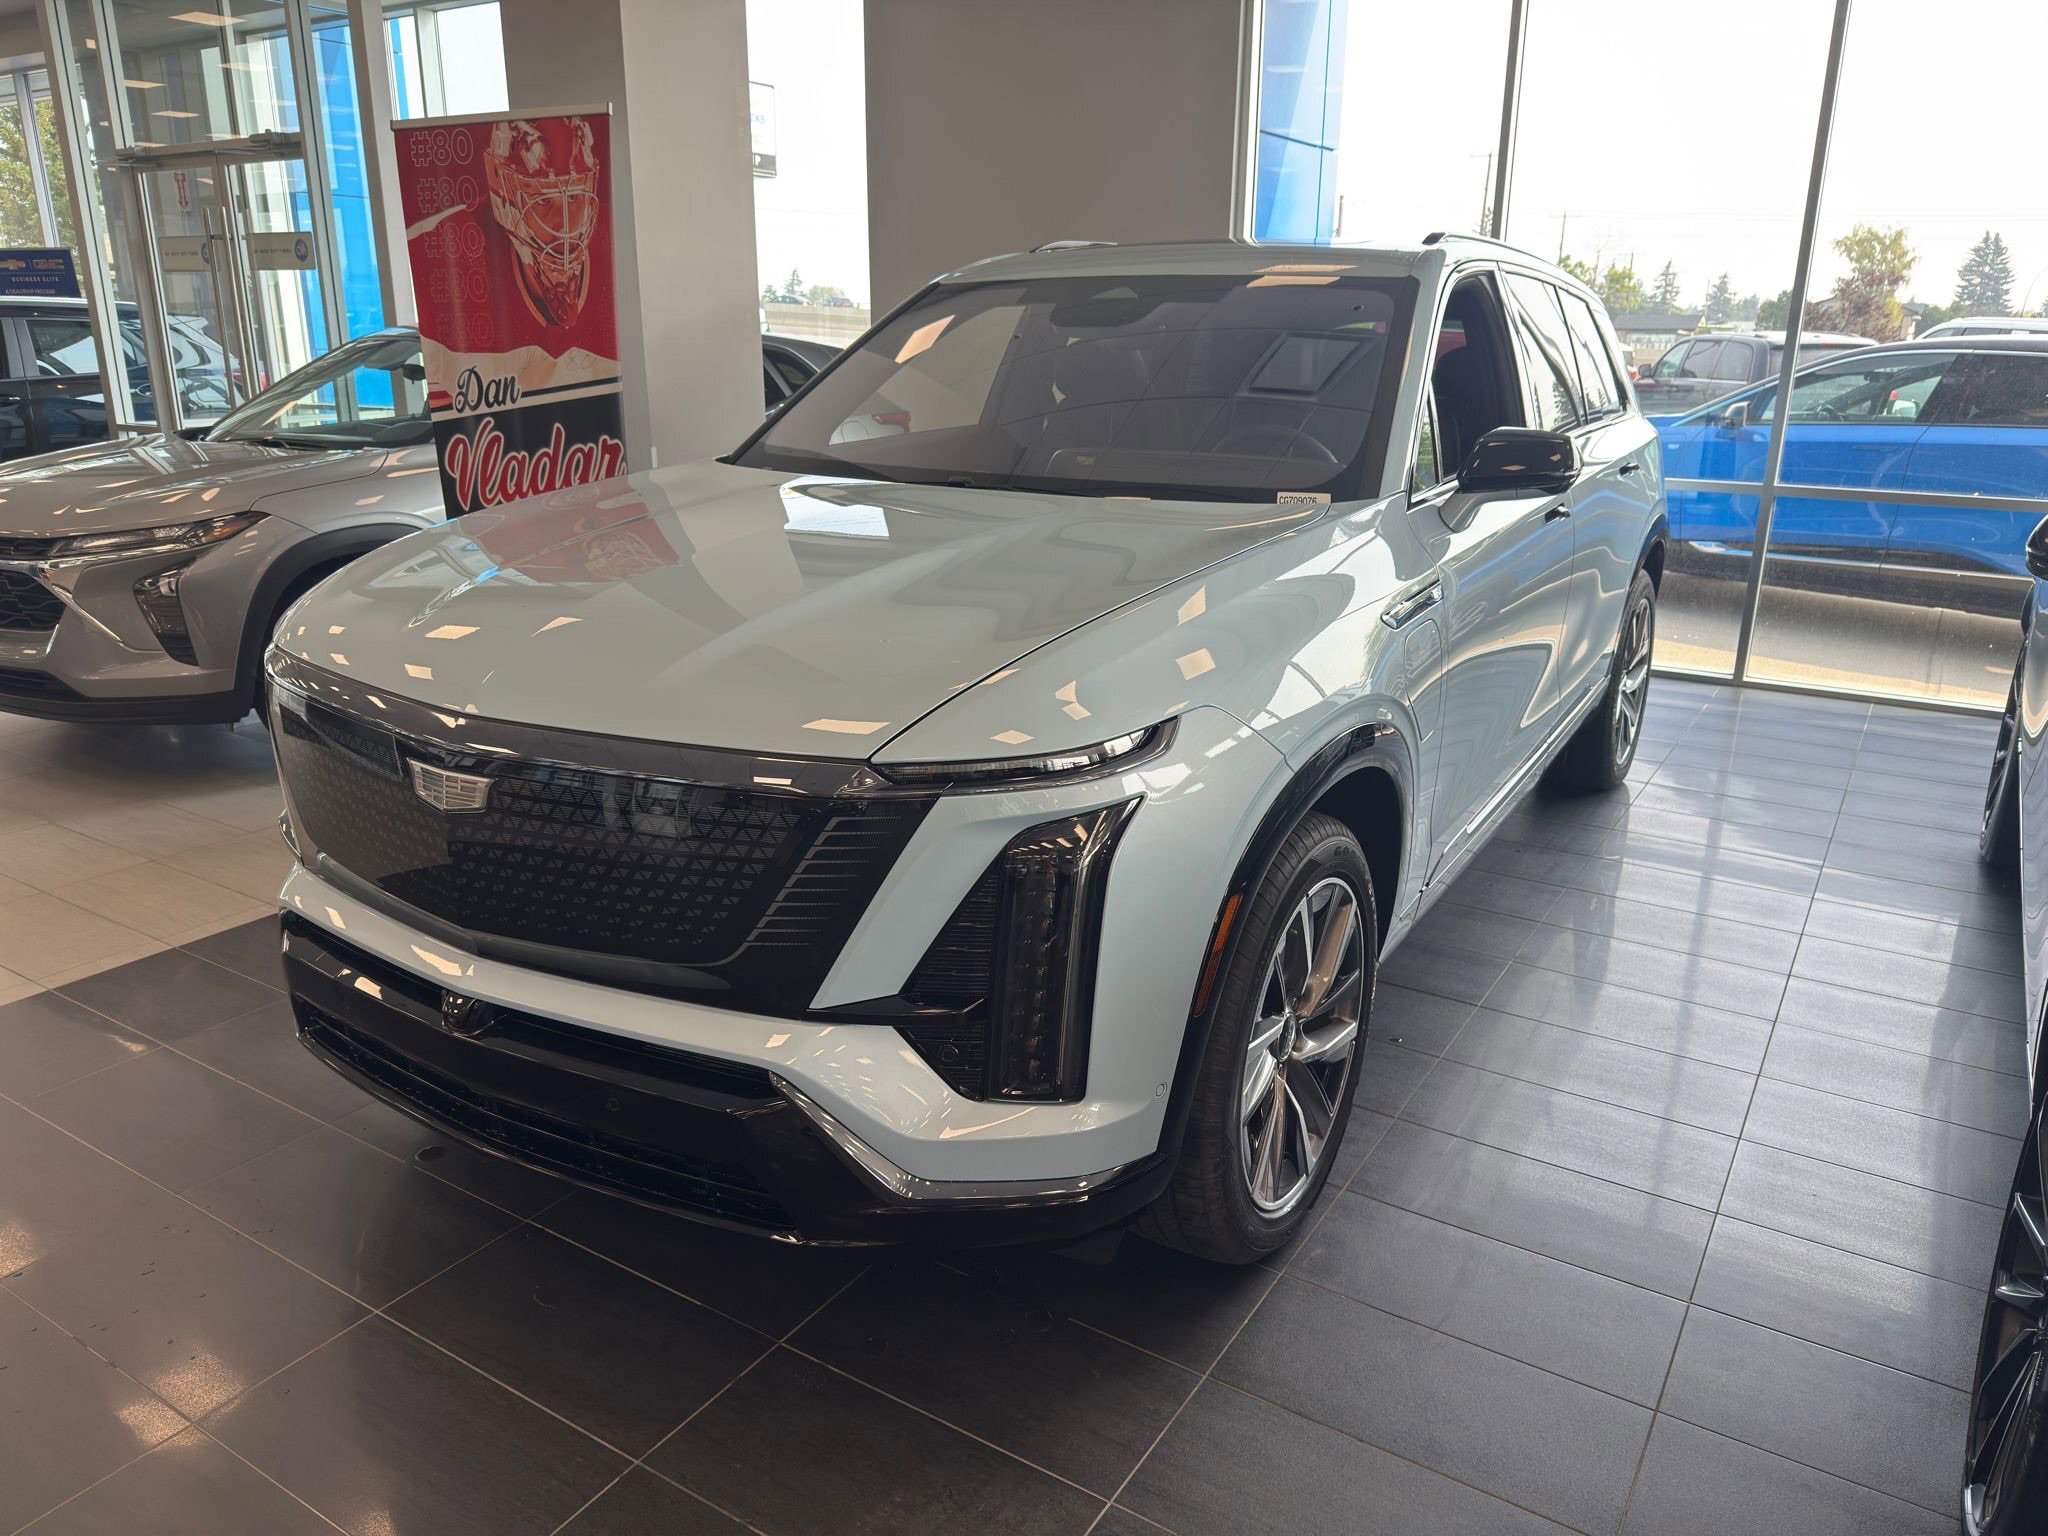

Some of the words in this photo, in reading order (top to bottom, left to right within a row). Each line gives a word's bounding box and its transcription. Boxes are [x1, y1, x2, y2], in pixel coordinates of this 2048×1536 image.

[410, 128, 473, 167] #80
[417, 175, 479, 213] #80
[424, 222, 485, 258] #80
[431, 267, 489, 303] #80
[455, 365, 520, 413] Dan
[445, 416, 627, 511] Vladar
